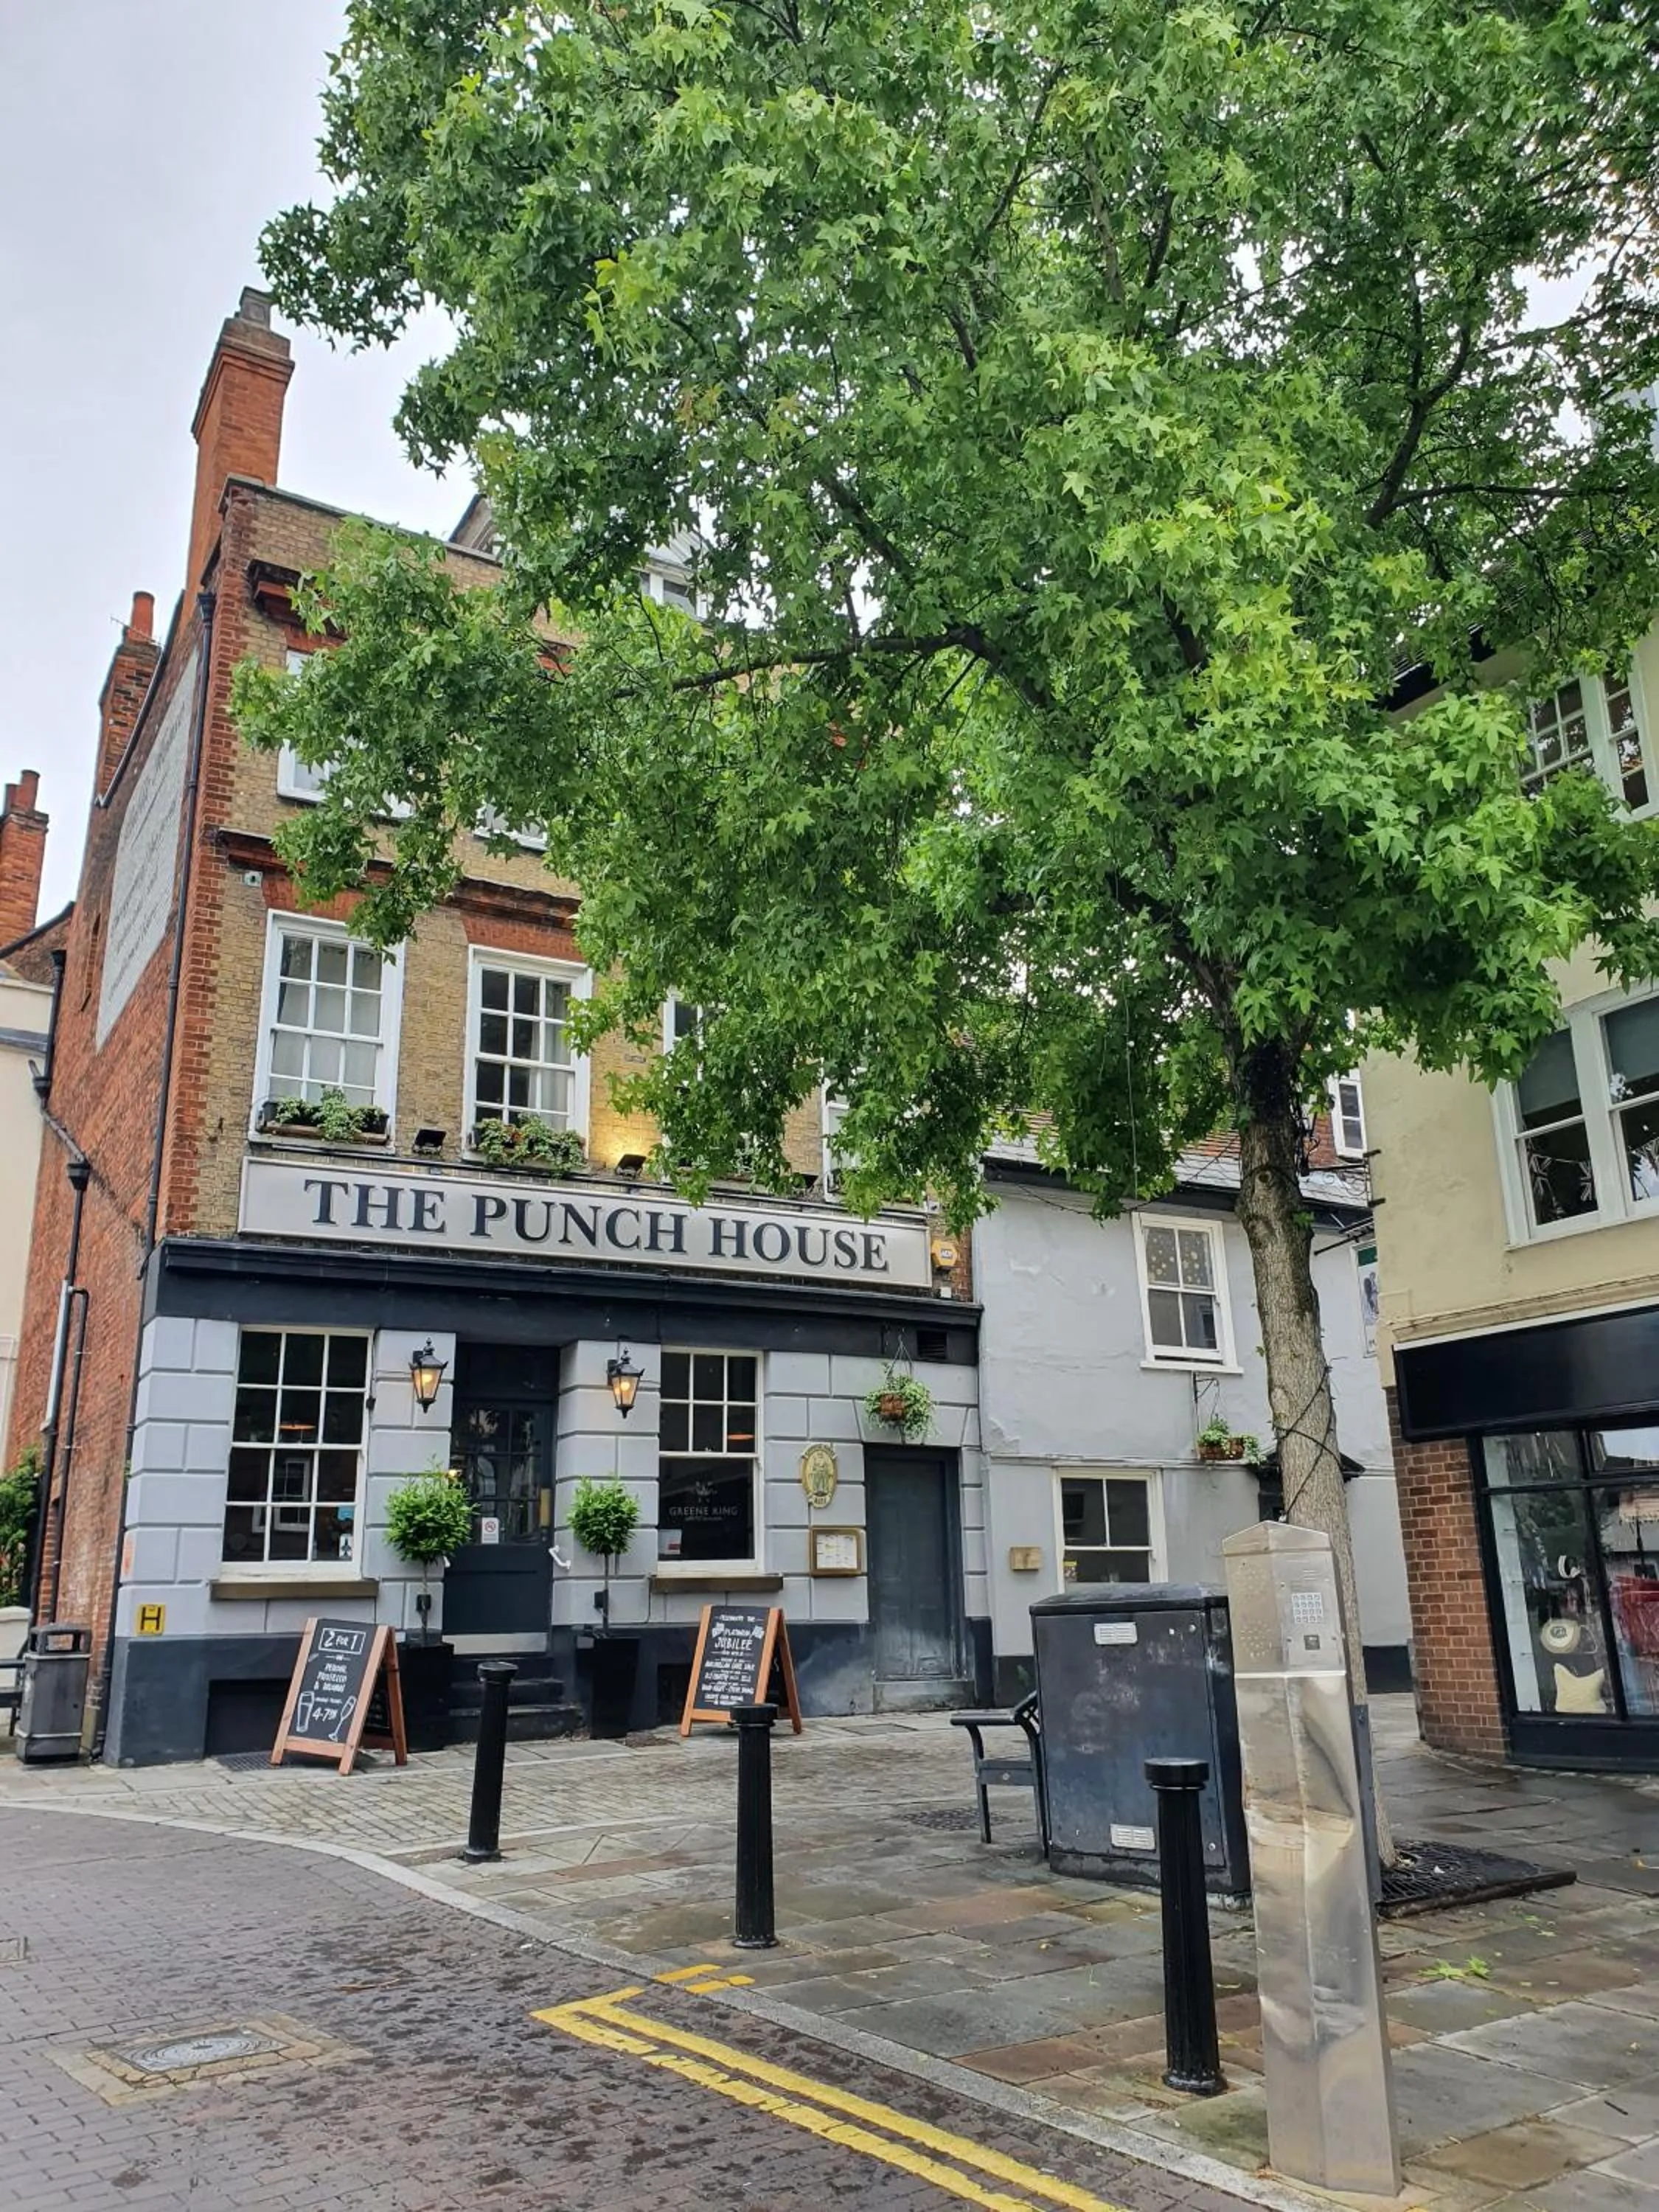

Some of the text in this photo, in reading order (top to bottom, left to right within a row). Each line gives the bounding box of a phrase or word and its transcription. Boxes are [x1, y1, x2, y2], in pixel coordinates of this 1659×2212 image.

[304, 1180, 888, 1273] THE PUNCH HOUSE
[669, 1506, 739, 1516] GREENE KING
[140, 1606, 161, 1632] H
[324, 1632, 358, 1650] 2 FOR 1
[714, 1637, 753, 1651] JUBILEE
